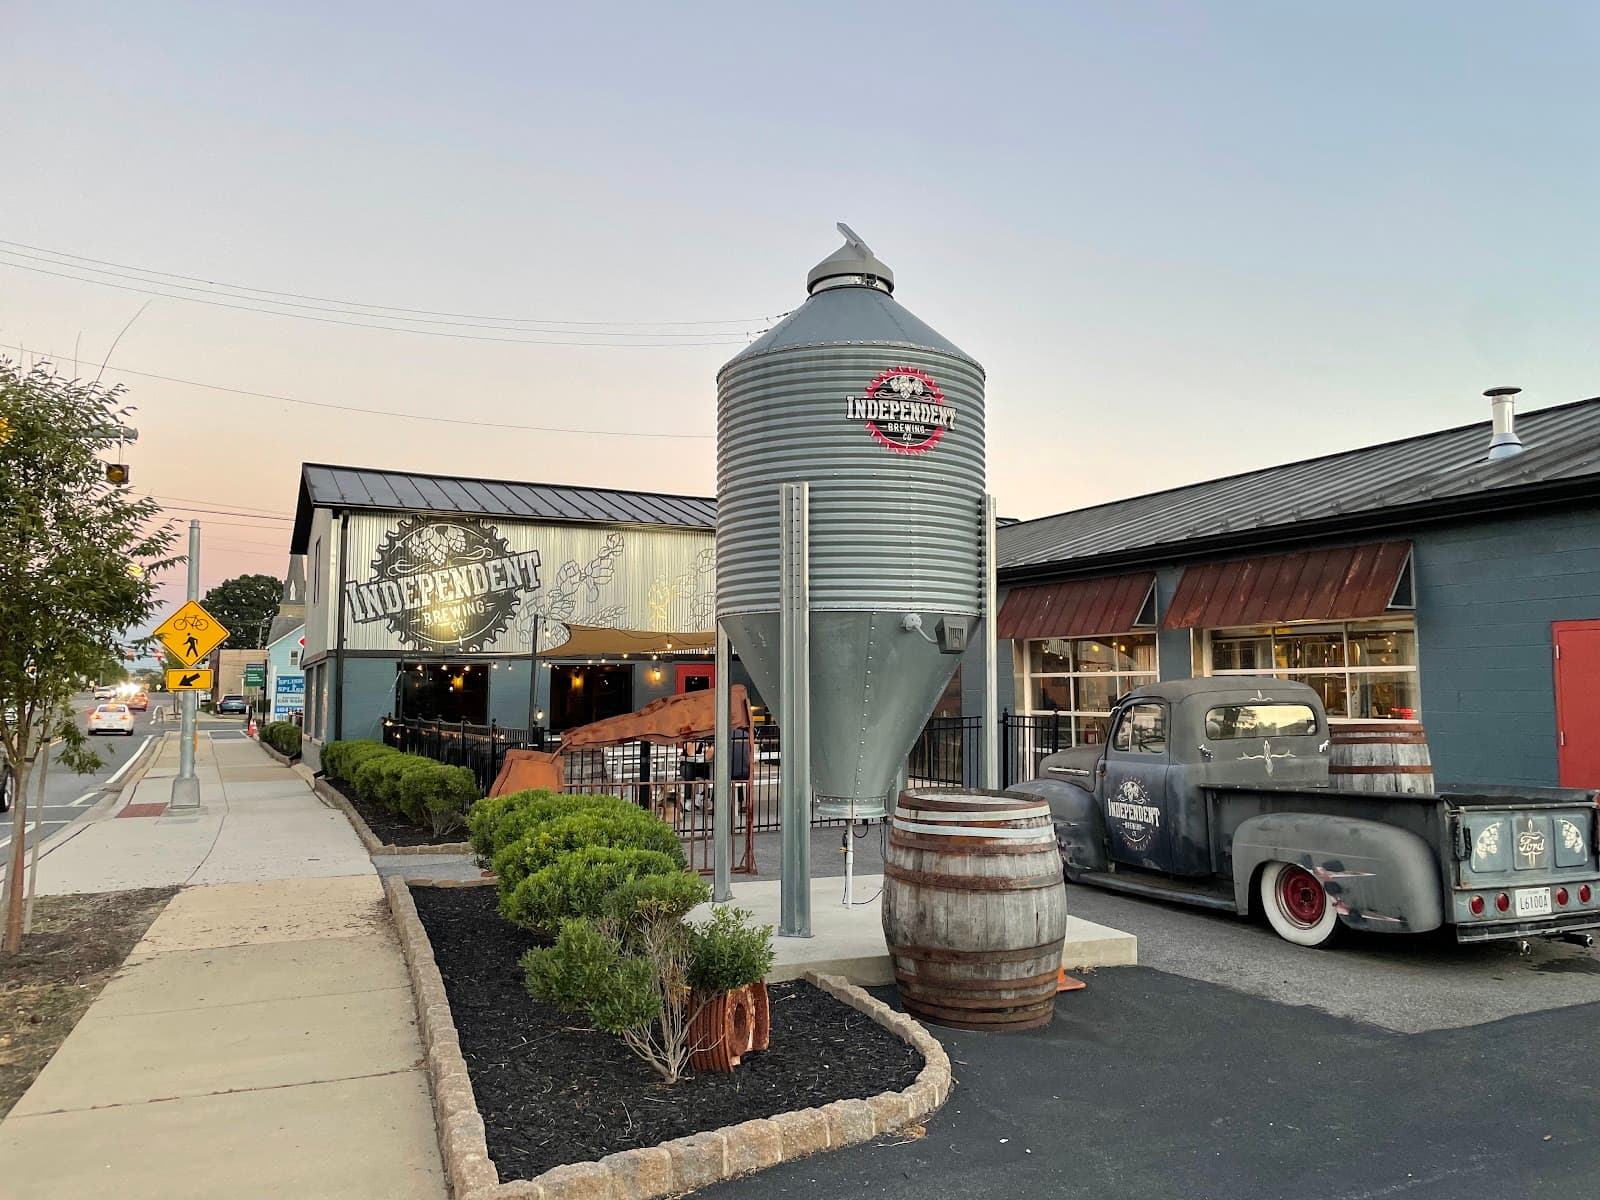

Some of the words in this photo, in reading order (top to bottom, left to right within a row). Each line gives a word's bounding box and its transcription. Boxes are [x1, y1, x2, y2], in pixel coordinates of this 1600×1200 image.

[846, 395, 957, 431] INDEPENDENT
[887, 422, 925, 434] BREWING
[345, 550, 541, 624] INDEPENDENT
[421, 600, 486, 627] BREWING
[1107, 798, 1160, 827] INDEPENDENT
[1518, 835, 1545, 852] Ford
